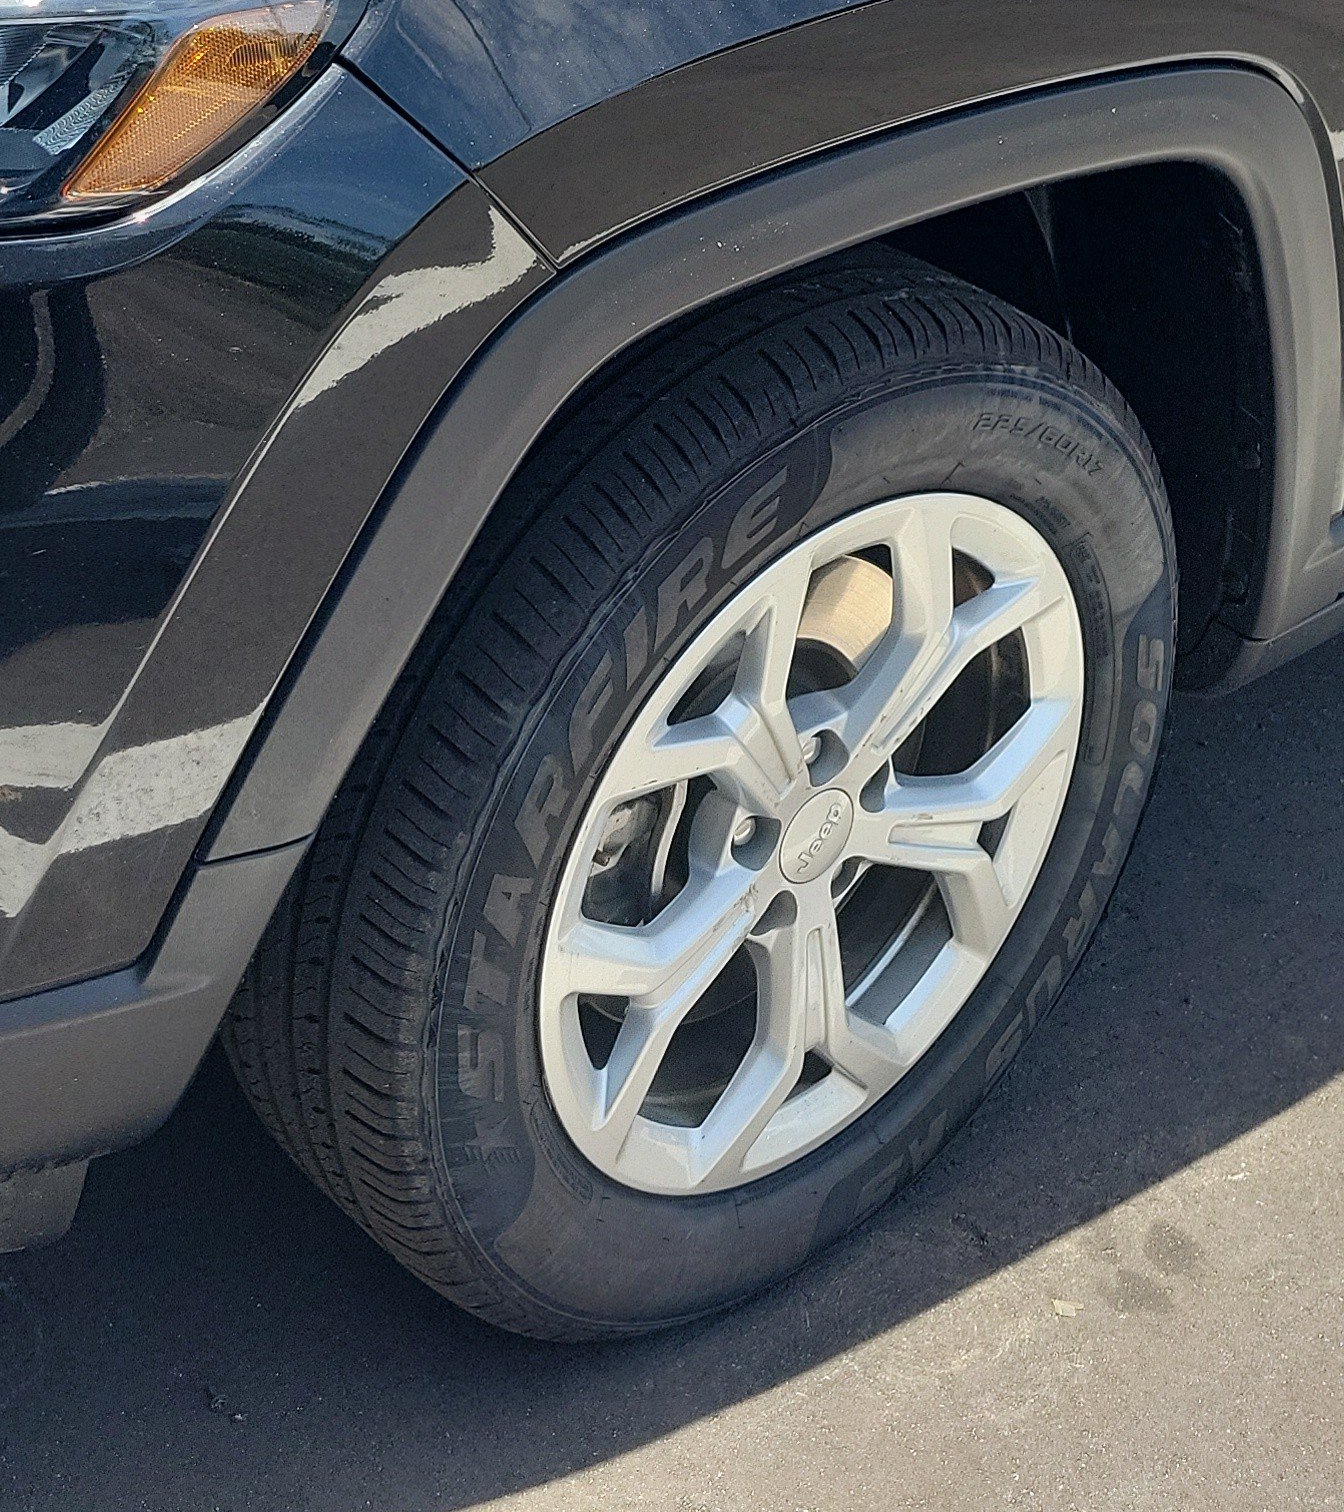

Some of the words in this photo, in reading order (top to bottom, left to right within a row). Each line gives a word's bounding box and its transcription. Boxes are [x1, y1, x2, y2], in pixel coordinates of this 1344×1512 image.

[454, 464, 789, 1101] STARFIRE
[796, 801, 843, 875] Jeep
[983, 632, 1166, 1085] SOLARUS
